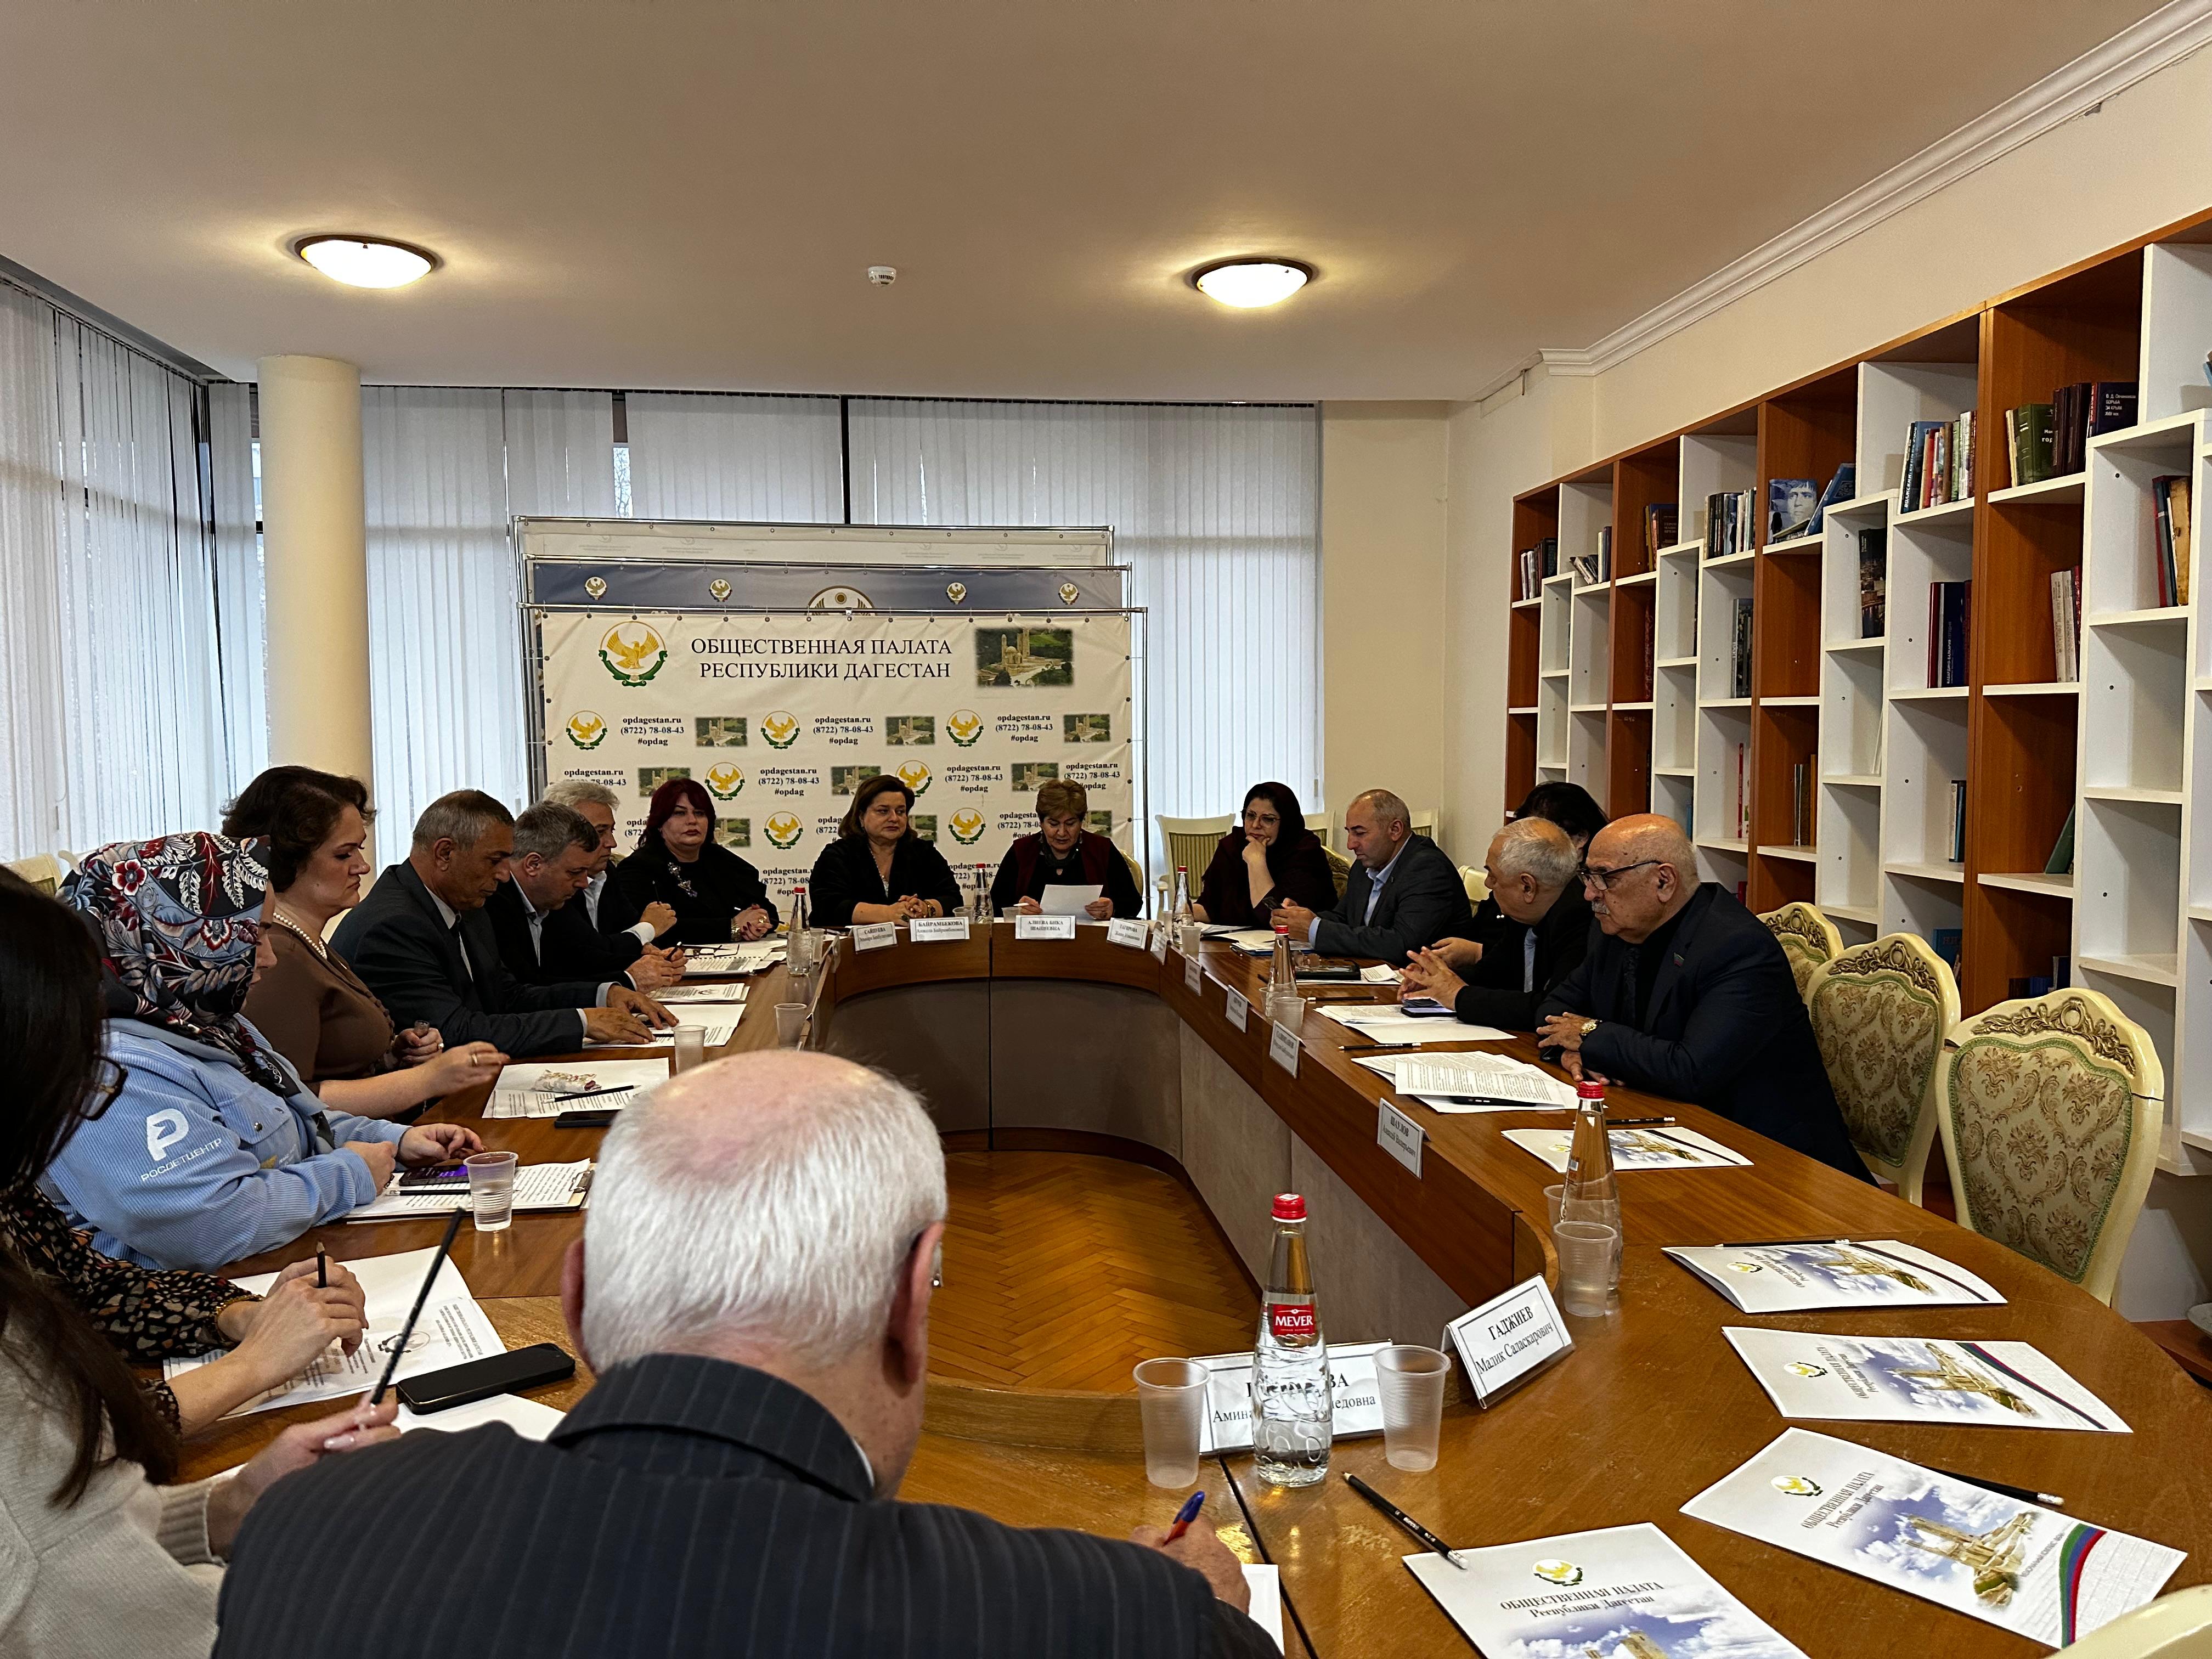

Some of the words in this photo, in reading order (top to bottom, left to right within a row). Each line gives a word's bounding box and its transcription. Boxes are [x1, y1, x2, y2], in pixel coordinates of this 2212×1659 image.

[691, 638, 865, 657] ОБЩЕСТВЕННАЯ
[871, 639, 952, 654] ПАЛАТА
[700, 662, 838, 679] РЕСПУБЛИКИ
[844, 663, 951, 681] ДАГЕСТАН
[620, 727, 647, 736] (8722)
[813, 726, 838, 735] (8722)
[995, 724, 1019, 732] (8722)
[637, 738, 668, 746] #opdag
[1011, 735, 1039, 743] #opdag
[1066, 762, 1118, 770] opdagestan.ru
[758, 777, 783, 786] (8722)
[945, 775, 969, 783] (8722)
[774, 788, 804, 796] #opdag
[997, 821, 1021, 830] (8722)
[140, 1138, 221, 1182] РОСДЕТЦЕНТР
[1275, 1315, 1313, 1327] MEVER
[1488, 1306, 1533, 1340] ГАДЖИЕВ
[1476, 1351, 1506, 1374] Малик
[1504, 1322, 1554, 1358] Саласкарович
[1500, 1588, 1611, 1611] ОБЩЕСТВЕННАЯ
[1612, 1582, 1665, 1597] ПАЛАТА
[1530, 1602, 1601, 1620] Республики
[1603, 1595, 1655, 1611] Дагестан
